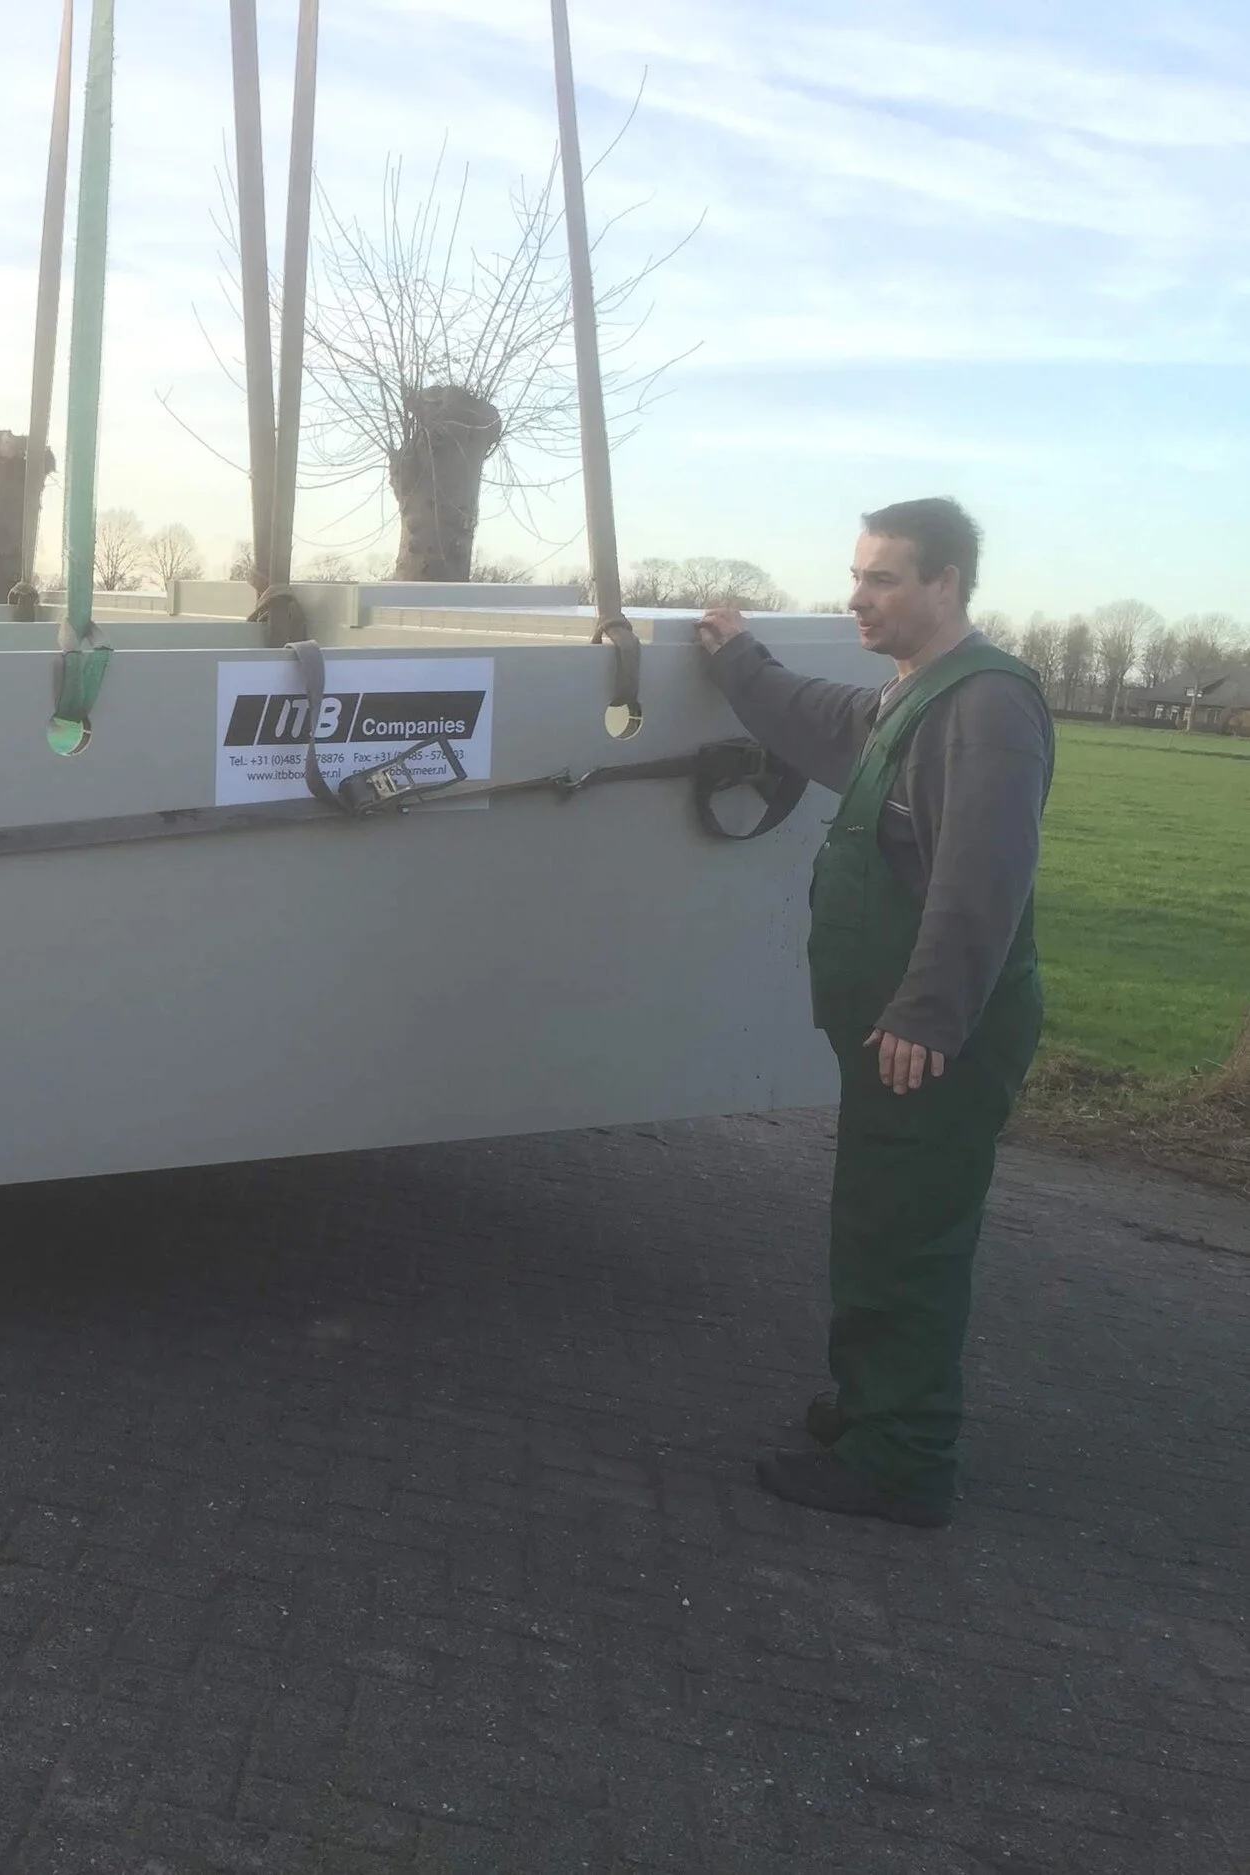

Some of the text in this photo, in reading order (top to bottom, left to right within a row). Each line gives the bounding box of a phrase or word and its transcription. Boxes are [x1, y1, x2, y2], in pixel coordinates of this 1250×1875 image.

[275, 697, 466, 738] ITB Companies
[250, 755, 268, 766] +31
[271, 754, 302, 766] (0)485
[311, 753, 345, 764] 78876
[373, 751, 390, 762] +31
[247, 767, 341, 780] www.itbboxer.nl
